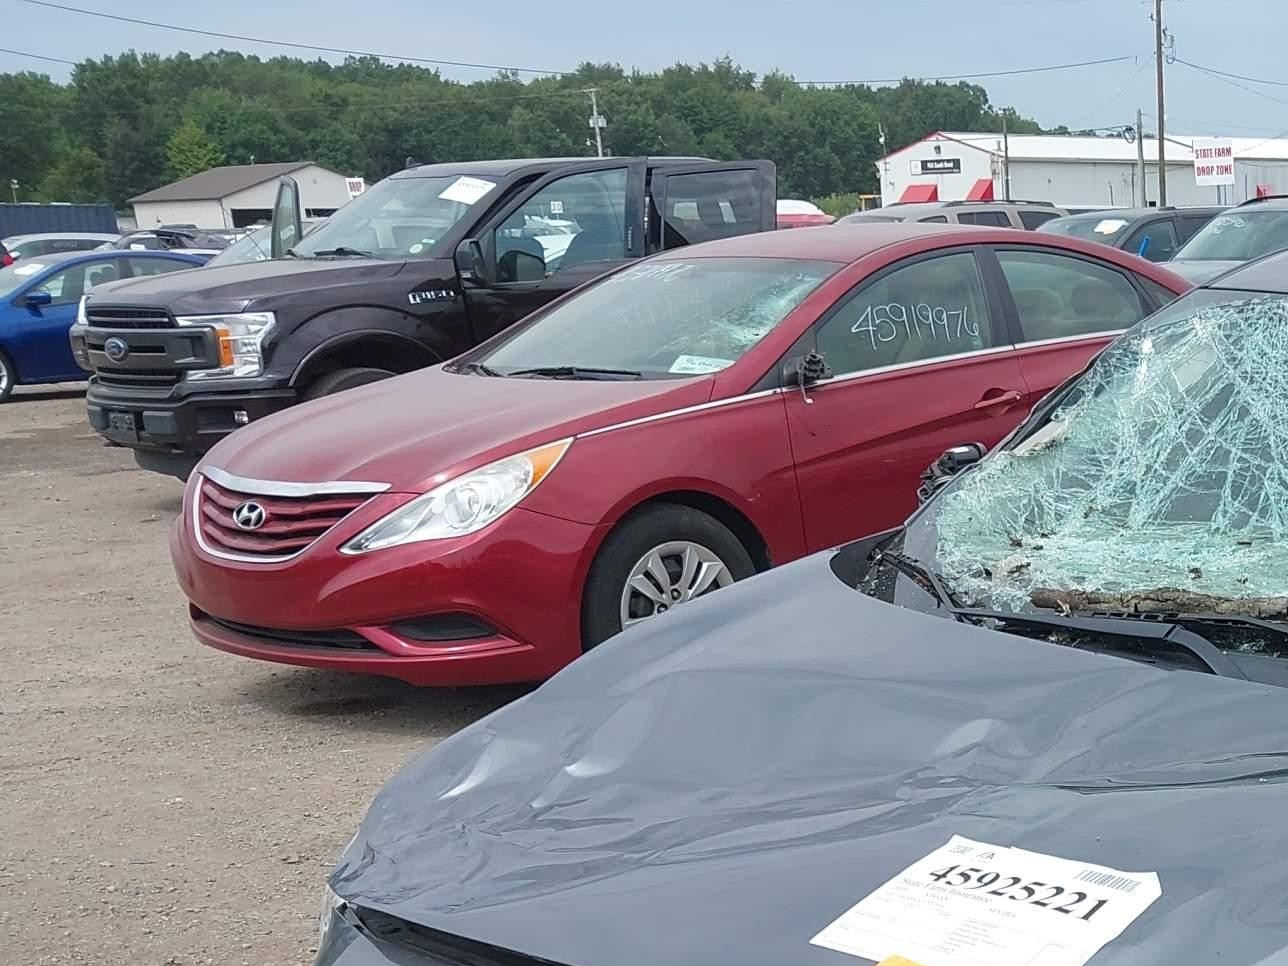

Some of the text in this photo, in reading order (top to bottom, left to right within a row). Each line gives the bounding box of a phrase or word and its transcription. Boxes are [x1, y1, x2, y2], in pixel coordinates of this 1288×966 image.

[1195, 147, 1232, 159] STATE FARM
[1197, 165, 1232, 176] DROP ZONE
[851, 303, 979, 350] 45919976
[929, 864, 1111, 922] 45925221
